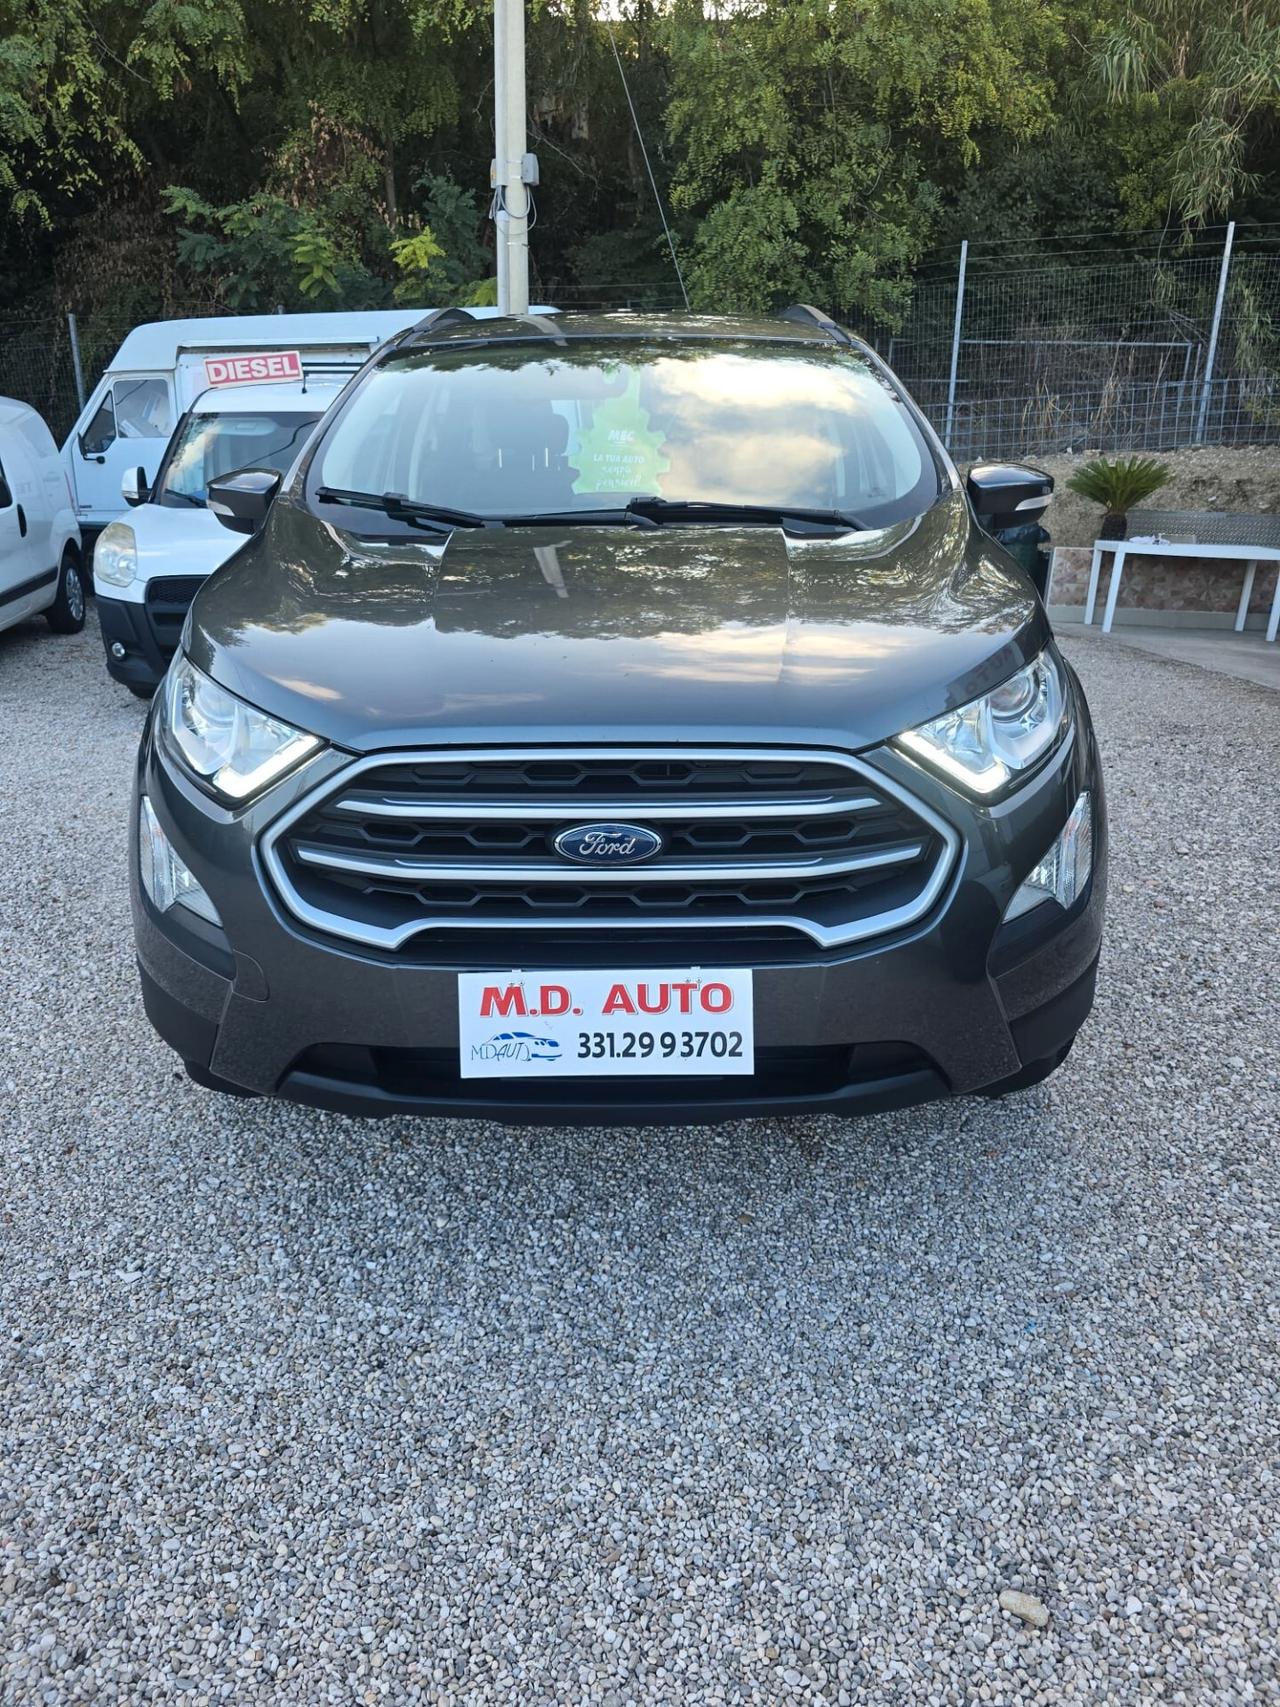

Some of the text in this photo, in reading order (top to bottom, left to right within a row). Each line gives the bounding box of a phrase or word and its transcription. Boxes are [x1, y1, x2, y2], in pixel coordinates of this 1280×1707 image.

[207, 356, 299, 382] DIESEL
[579, 831, 637, 855] Ford
[480, 982, 735, 1018] M.D. AUTO
